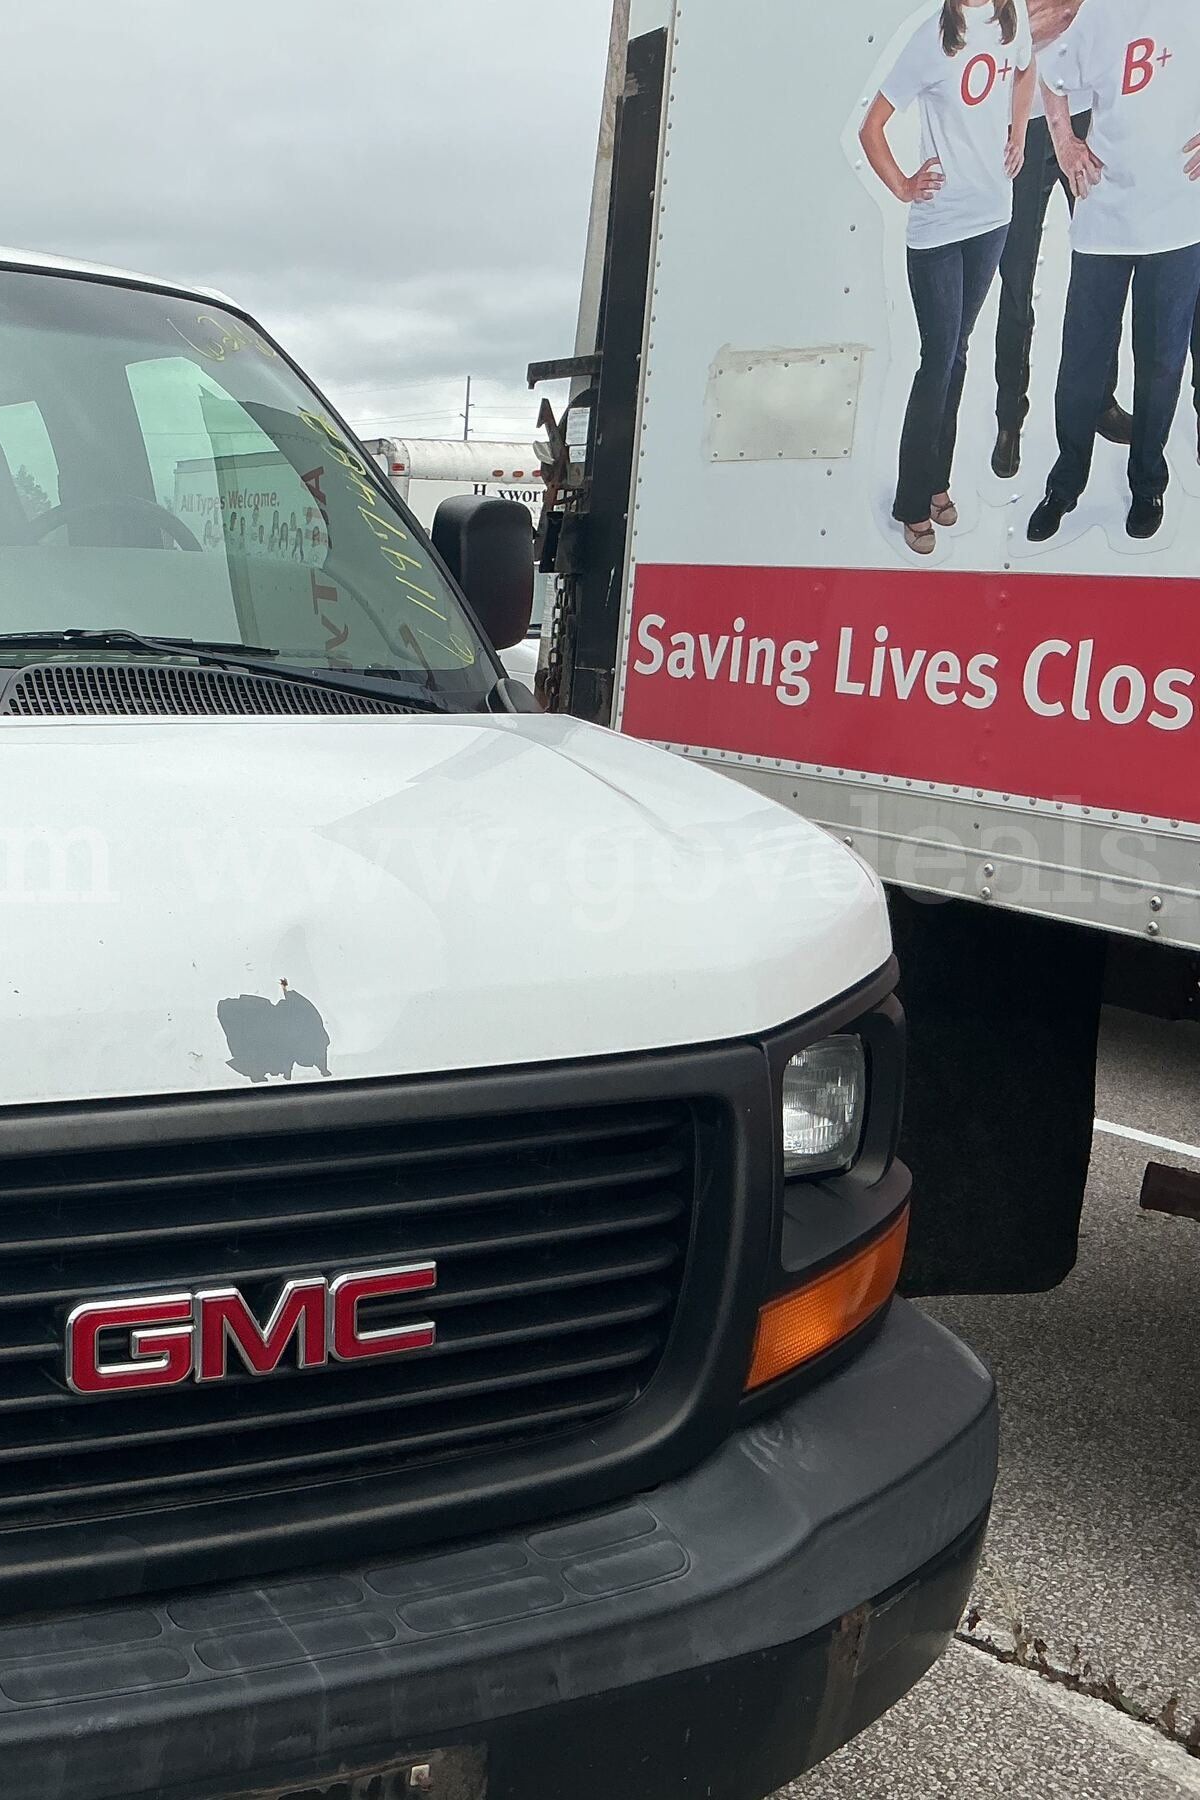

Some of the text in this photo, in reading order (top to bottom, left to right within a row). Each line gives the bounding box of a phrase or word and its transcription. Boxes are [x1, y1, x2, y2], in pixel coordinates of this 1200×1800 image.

[228, 488, 280, 509] Welcome.
[633, 613, 1196, 731] Saving Lives Clos
[66, 1261, 437, 1394] GMC
